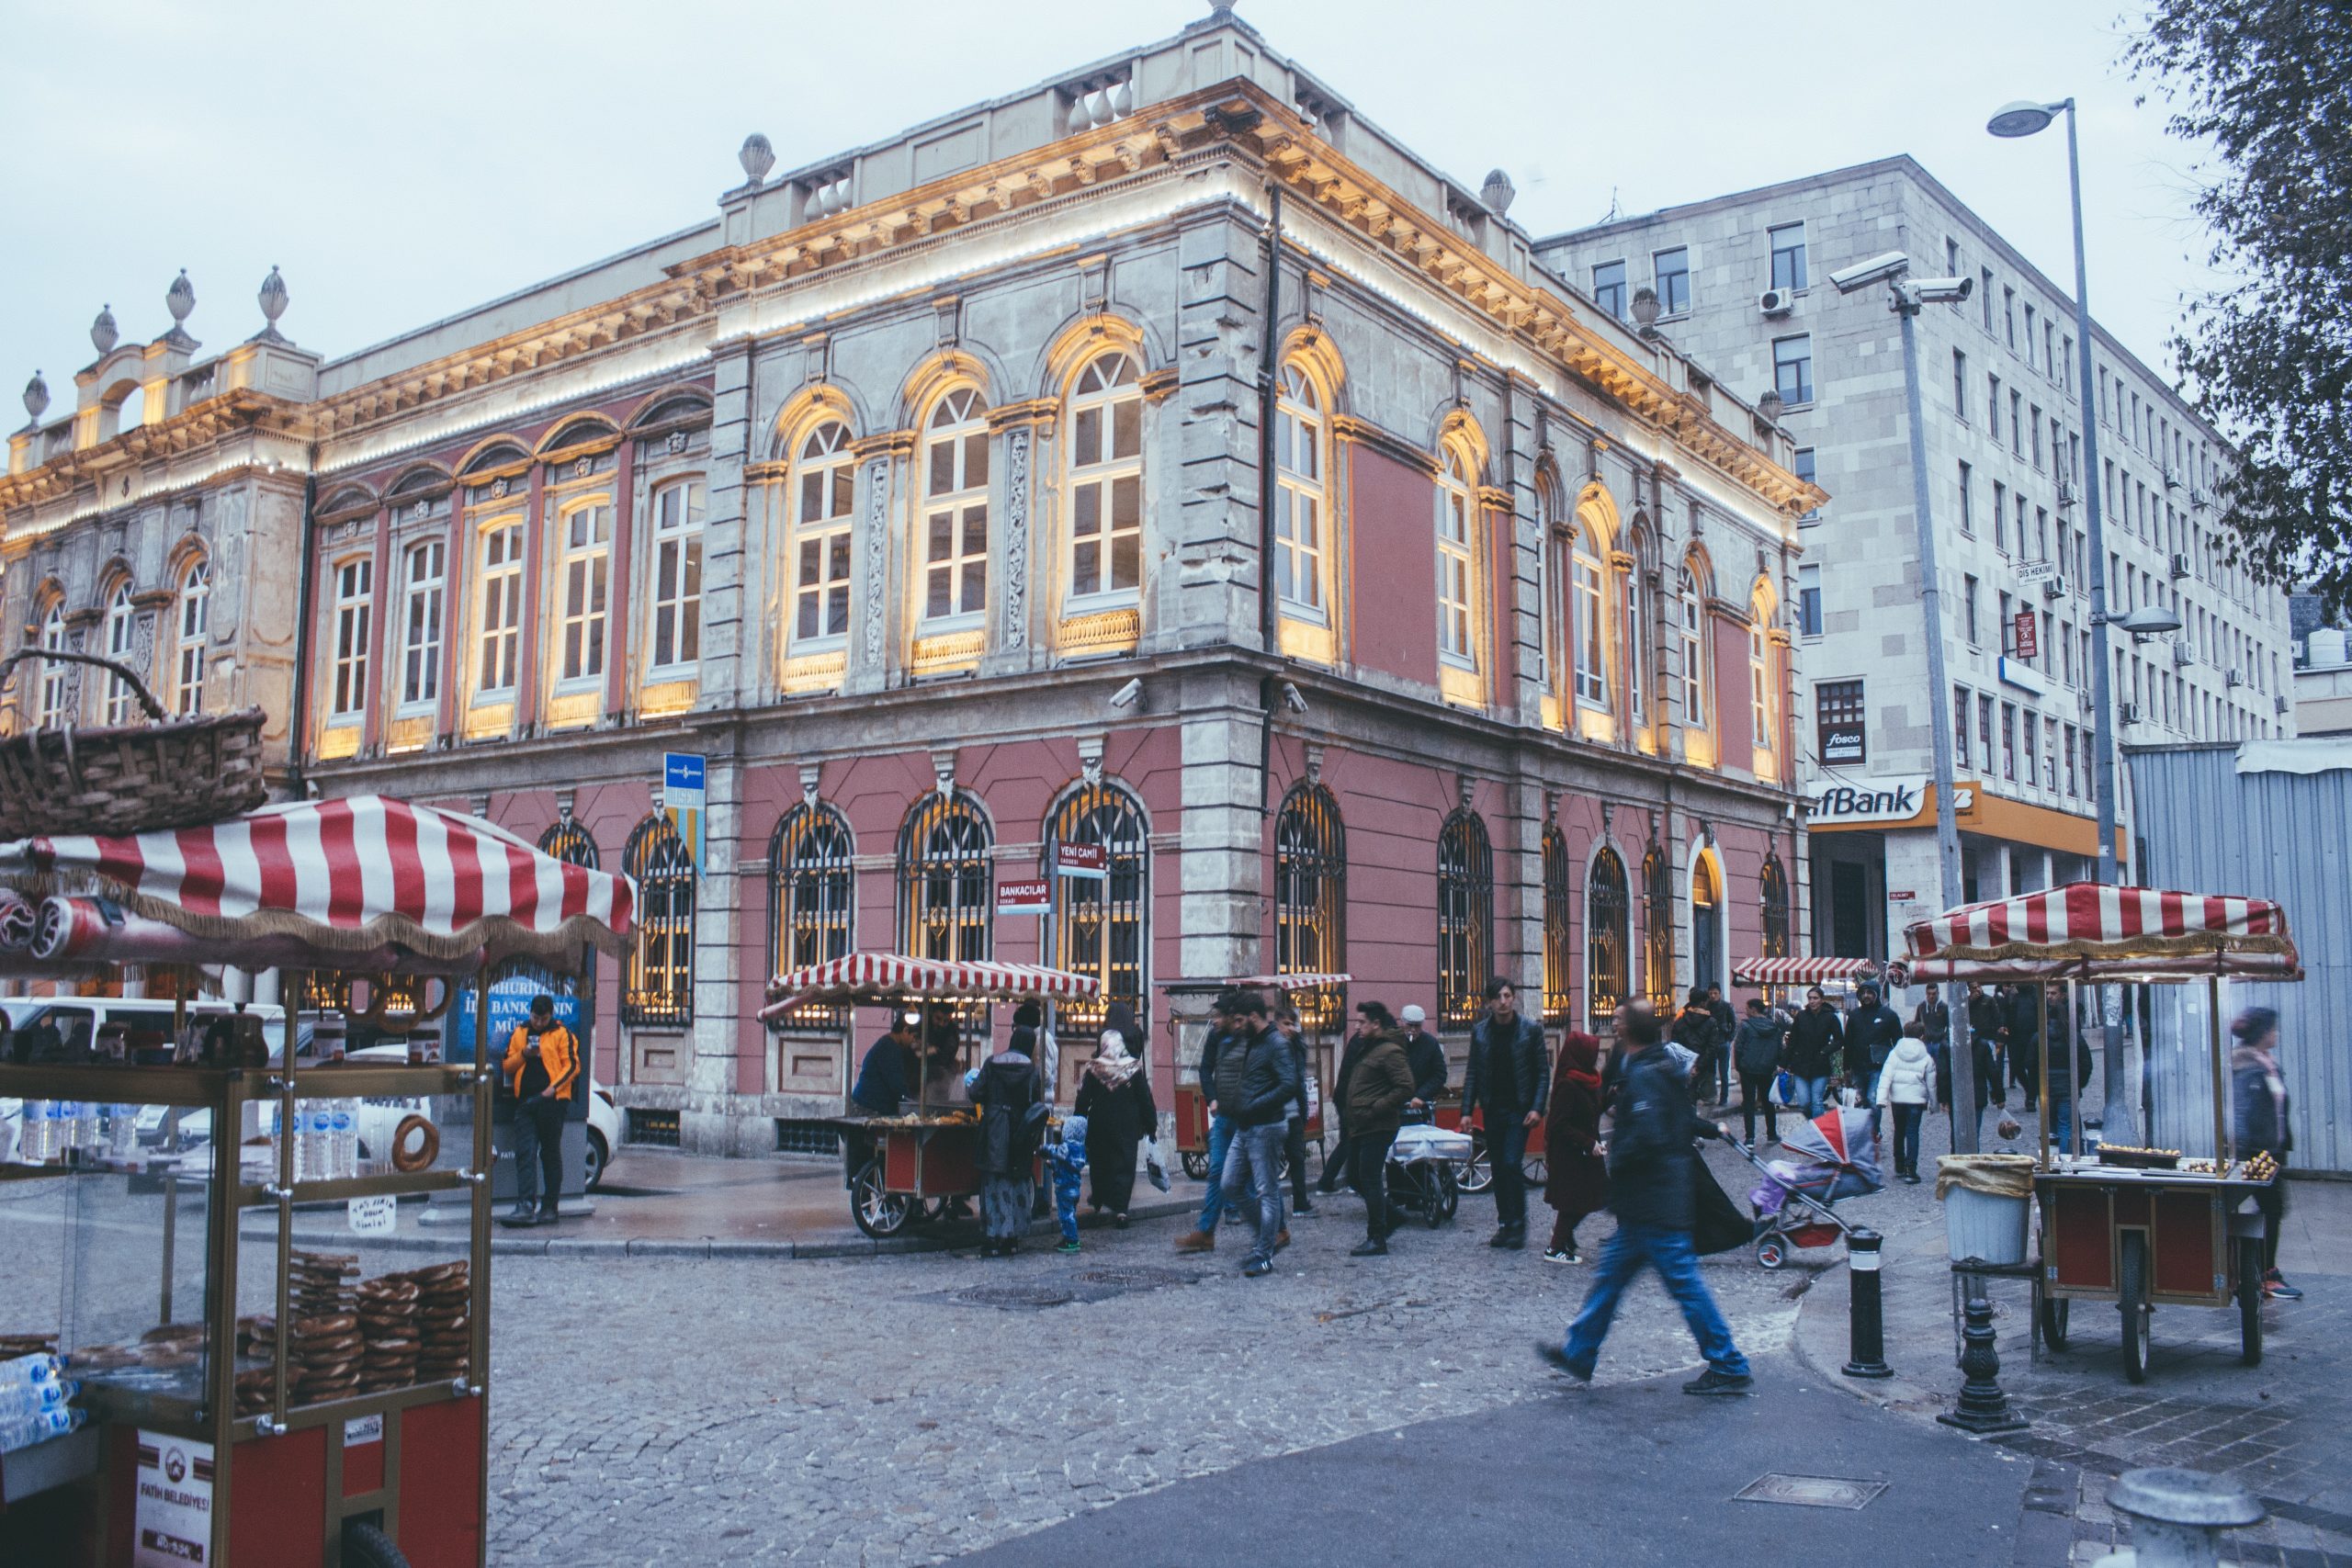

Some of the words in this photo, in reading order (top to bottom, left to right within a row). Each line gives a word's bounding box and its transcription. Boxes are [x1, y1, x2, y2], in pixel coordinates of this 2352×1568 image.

[1826, 733, 1860, 747] fosco
[1060, 843, 1077, 858] YENİ
[1000, 885, 1046, 897] BANKACILAR
[491, 1000, 573, 1015] BANKNIN
